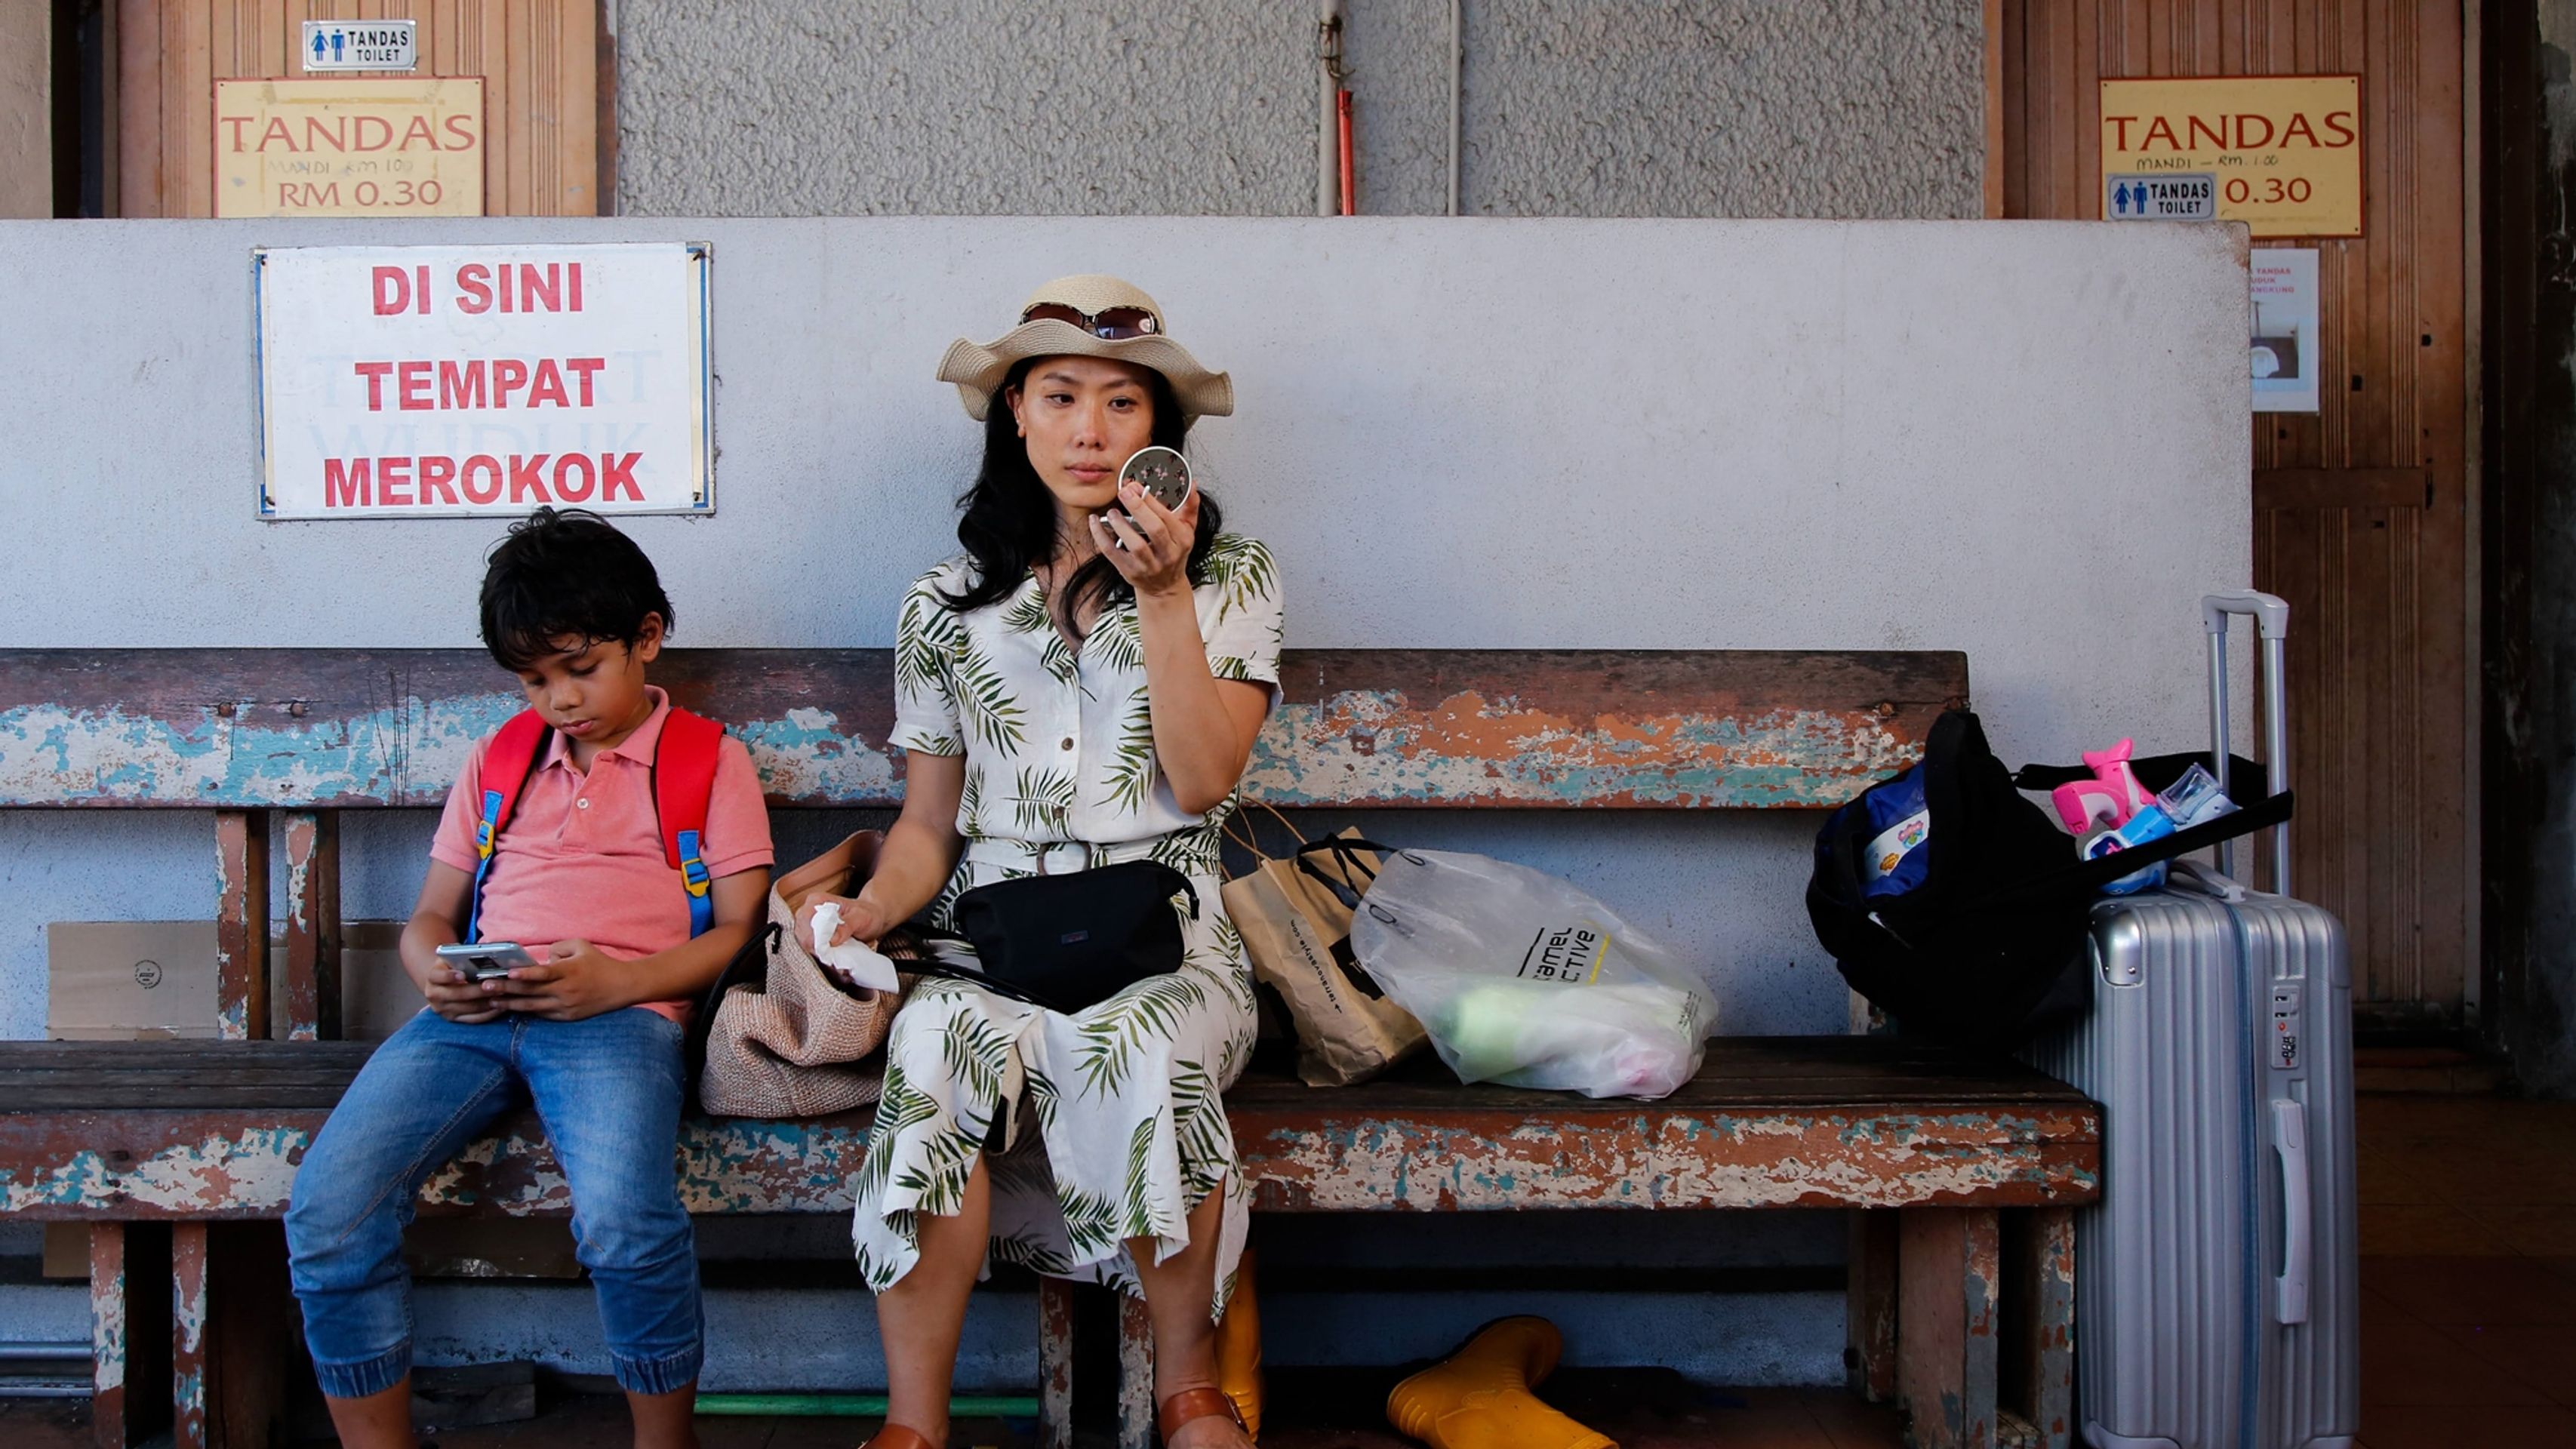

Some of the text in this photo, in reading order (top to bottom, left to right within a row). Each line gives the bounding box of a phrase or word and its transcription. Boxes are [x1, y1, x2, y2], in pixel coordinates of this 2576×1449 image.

[349, 31, 408, 46] TANDAS
[357, 49, 400, 61] TOILET
[220, 114, 476, 153] TANDAS
[2105, 111, 2356, 151] TANDAS
[2137, 158, 2192, 171] MANDI
[279, 180, 443, 207] RM 0.30
[2151, 183, 2209, 199] TANDAS
[2225, 177, 2313, 204] 0.30
[2159, 202, 2201, 214] TOILET
[372, 262, 583, 315] DI SINI
[353, 357, 606, 412] TEMPAT
[323, 452, 645, 508] MEROKOK
[1291, 919, 1337, 1002] terranovastyle.com
